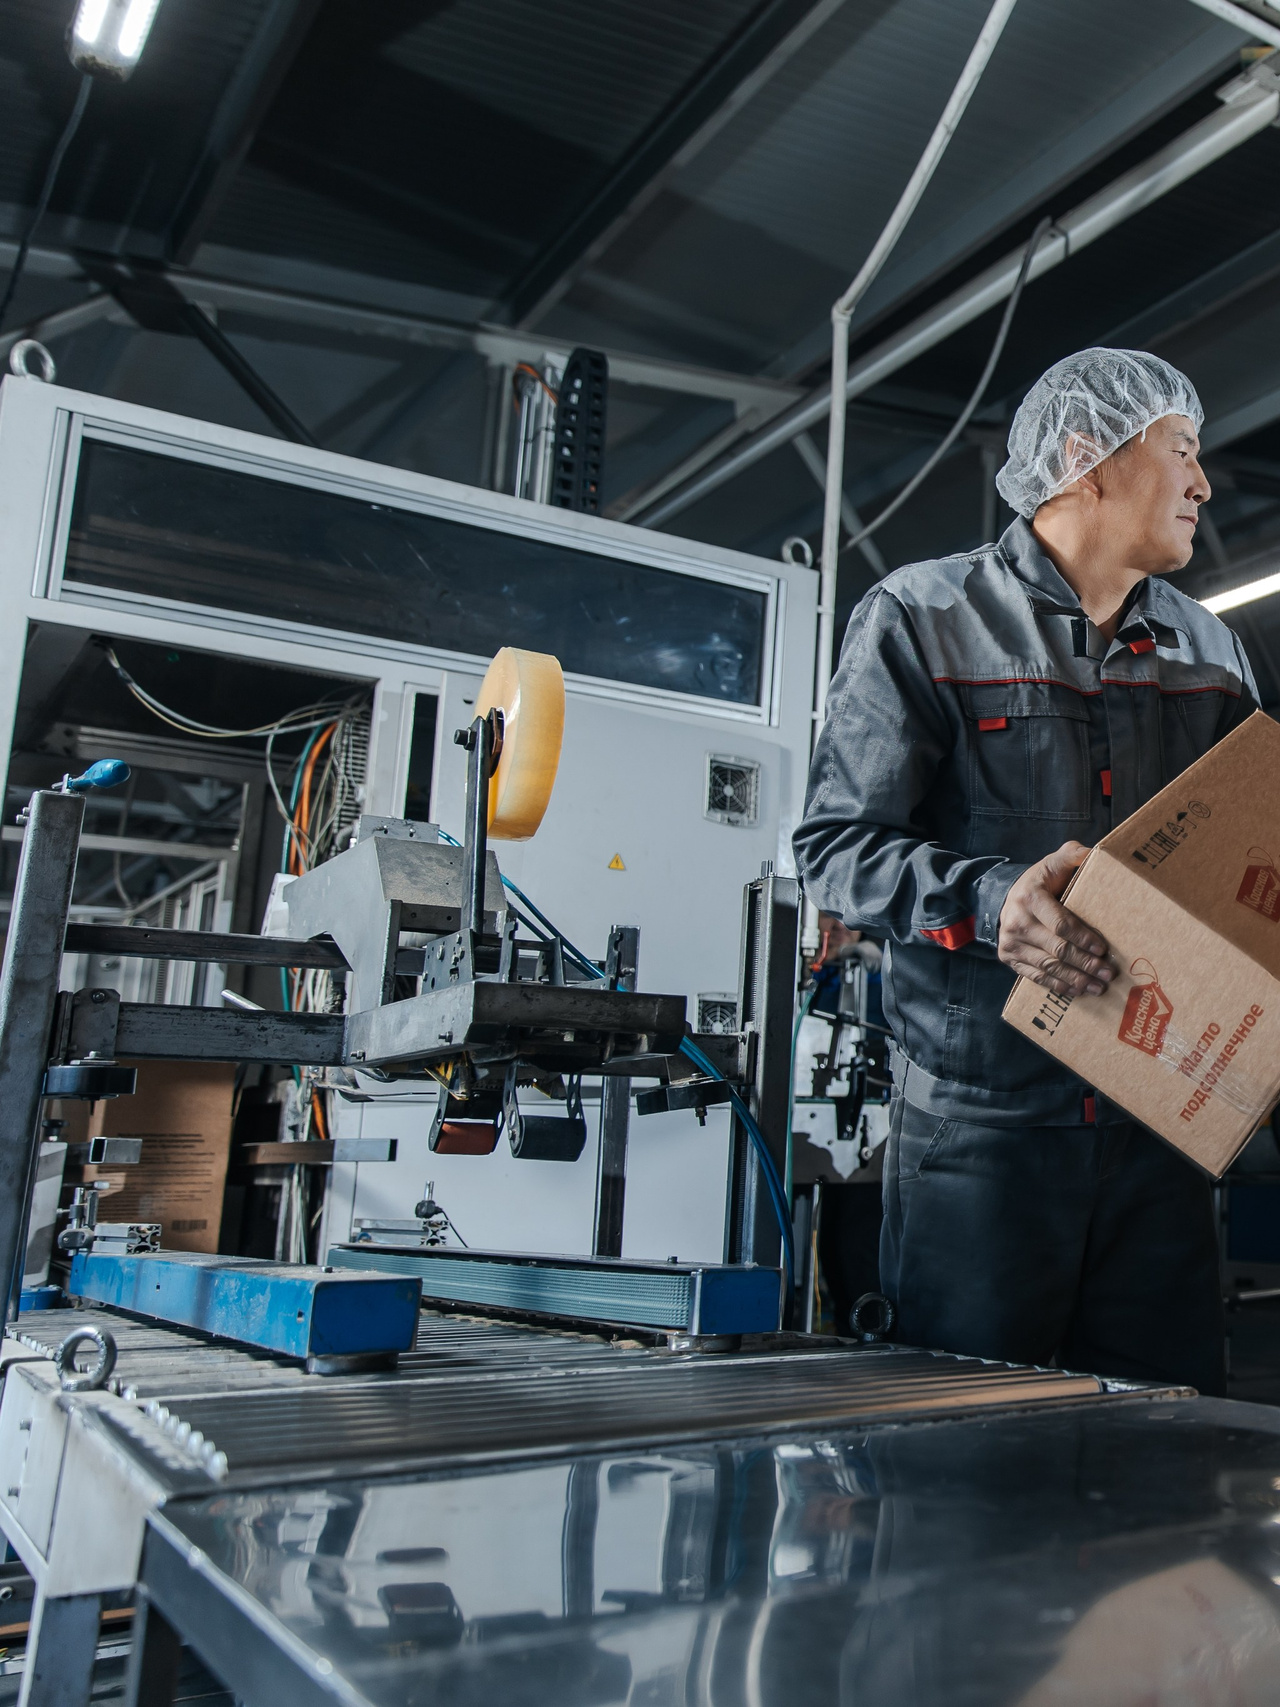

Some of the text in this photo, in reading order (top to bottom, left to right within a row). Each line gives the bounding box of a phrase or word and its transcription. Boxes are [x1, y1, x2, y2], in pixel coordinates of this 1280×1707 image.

[1243, 869, 1270, 908] Красная
[1261, 889, 1277, 915] цена
[1046, 989, 1075, 1012] EA
[1124, 989, 1154, 1044] Красная
[1143, 1016, 1160, 1050] цена
[1178, 1022, 1221, 1078] Масло
[1179, 1002, 1265, 1122] подсолнечное
